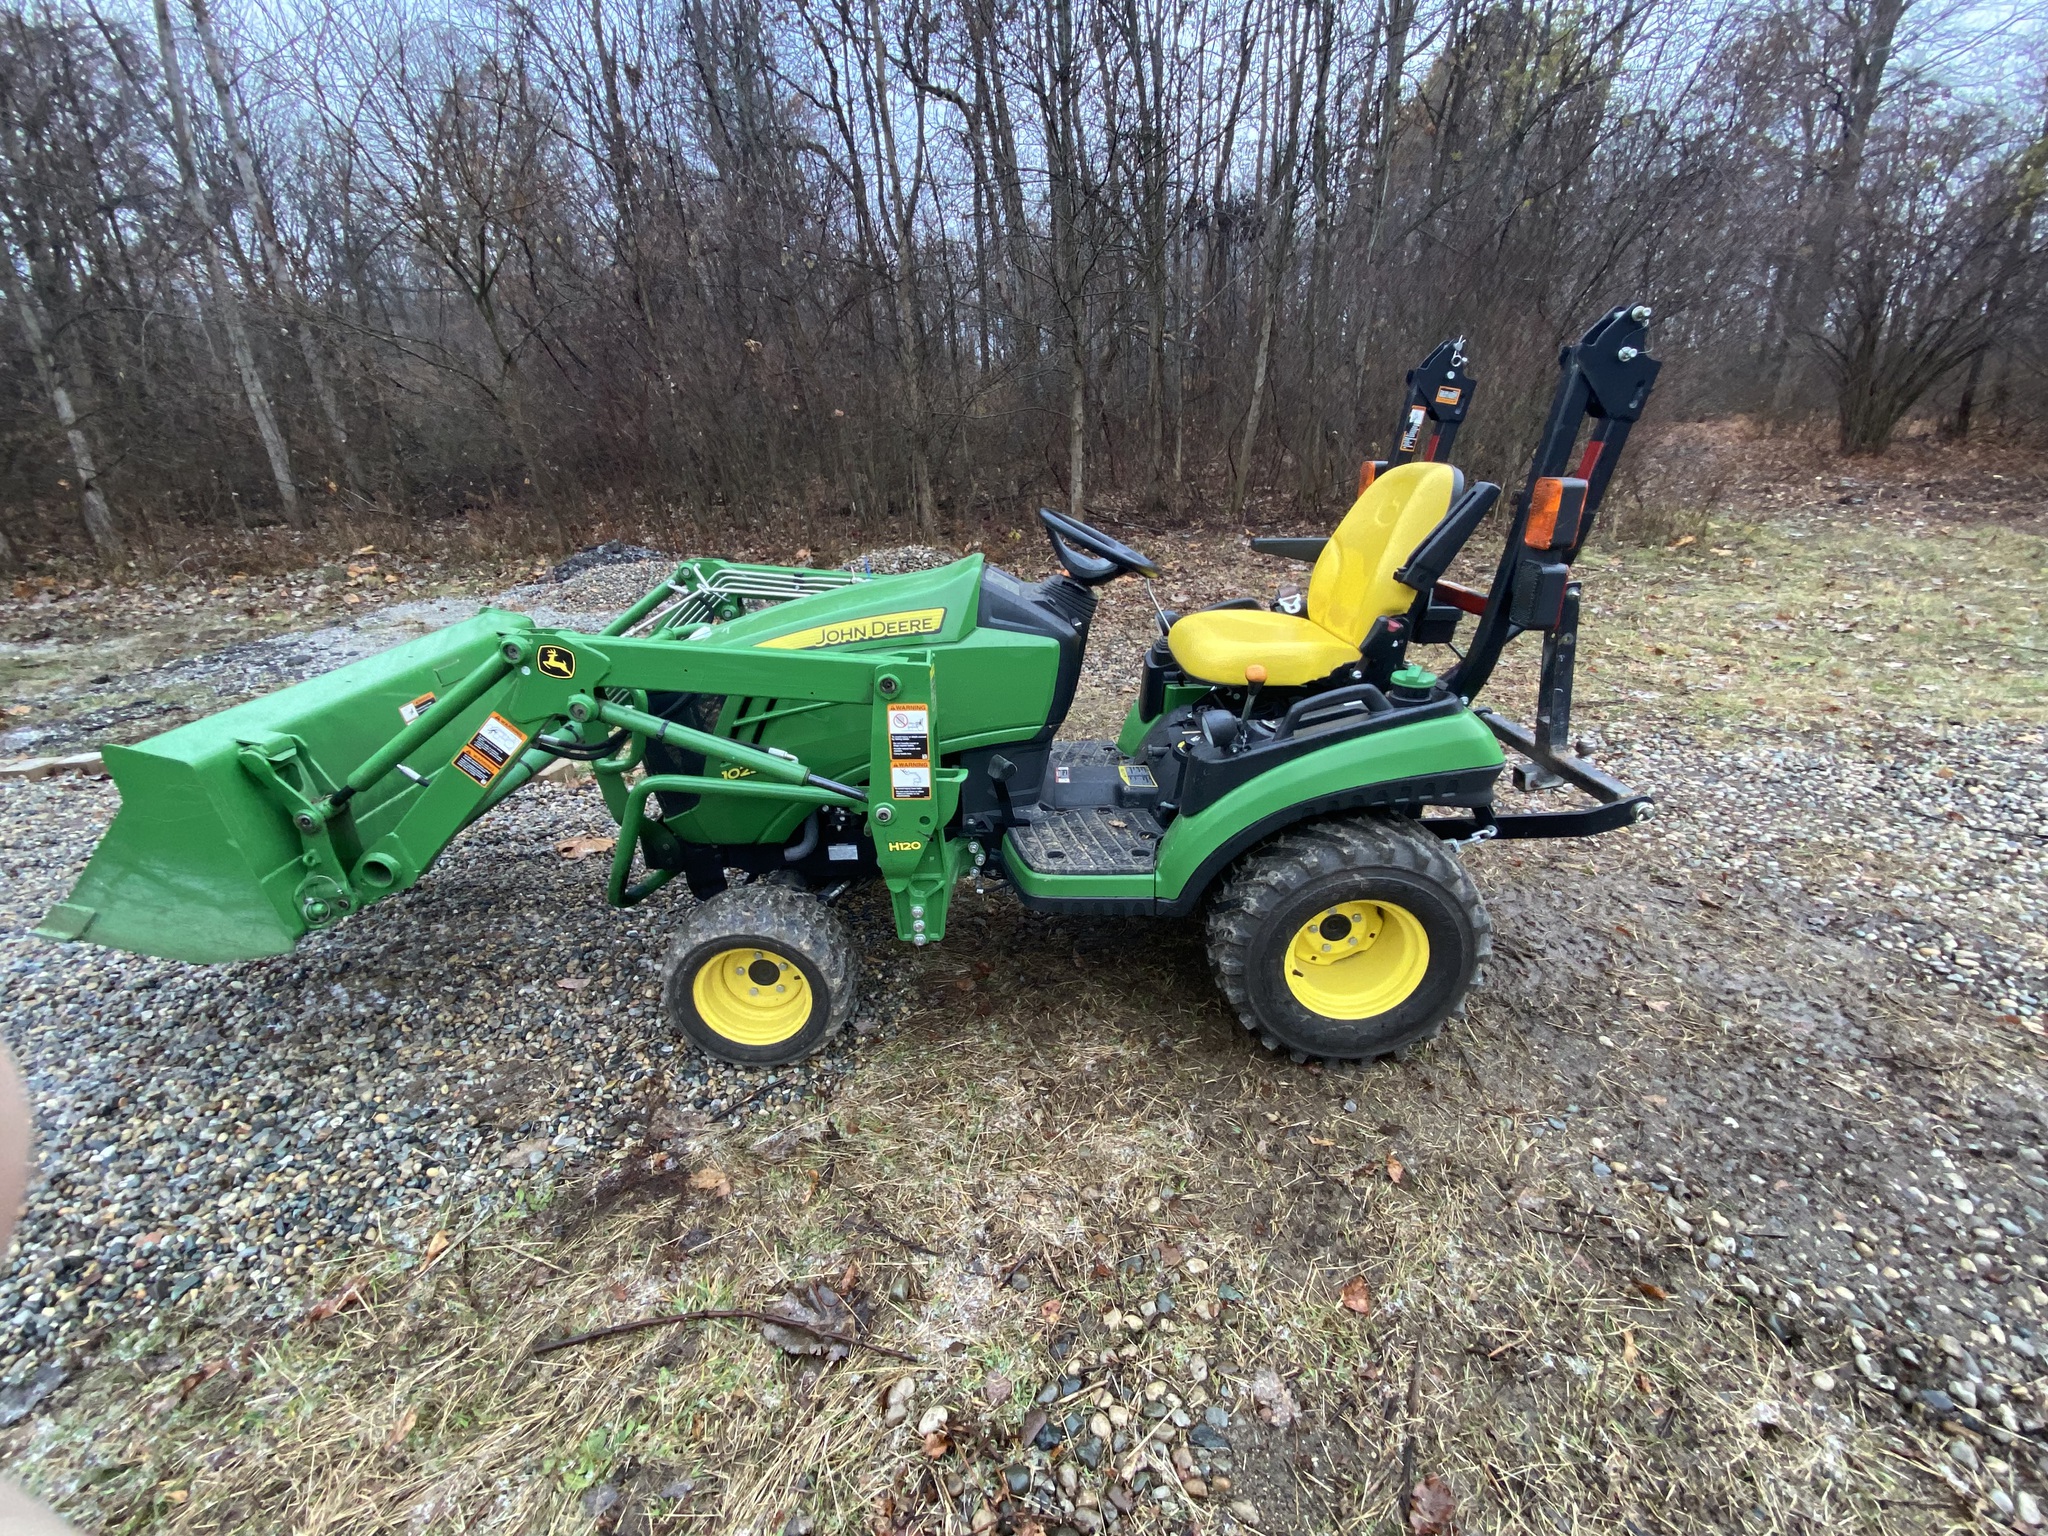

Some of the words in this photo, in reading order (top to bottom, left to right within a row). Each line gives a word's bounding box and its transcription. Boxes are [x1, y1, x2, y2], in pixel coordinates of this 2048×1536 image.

[815, 626, 867, 645] JOHN
[871, 618, 933, 637] DEERE
[888, 841, 922, 852] H120
